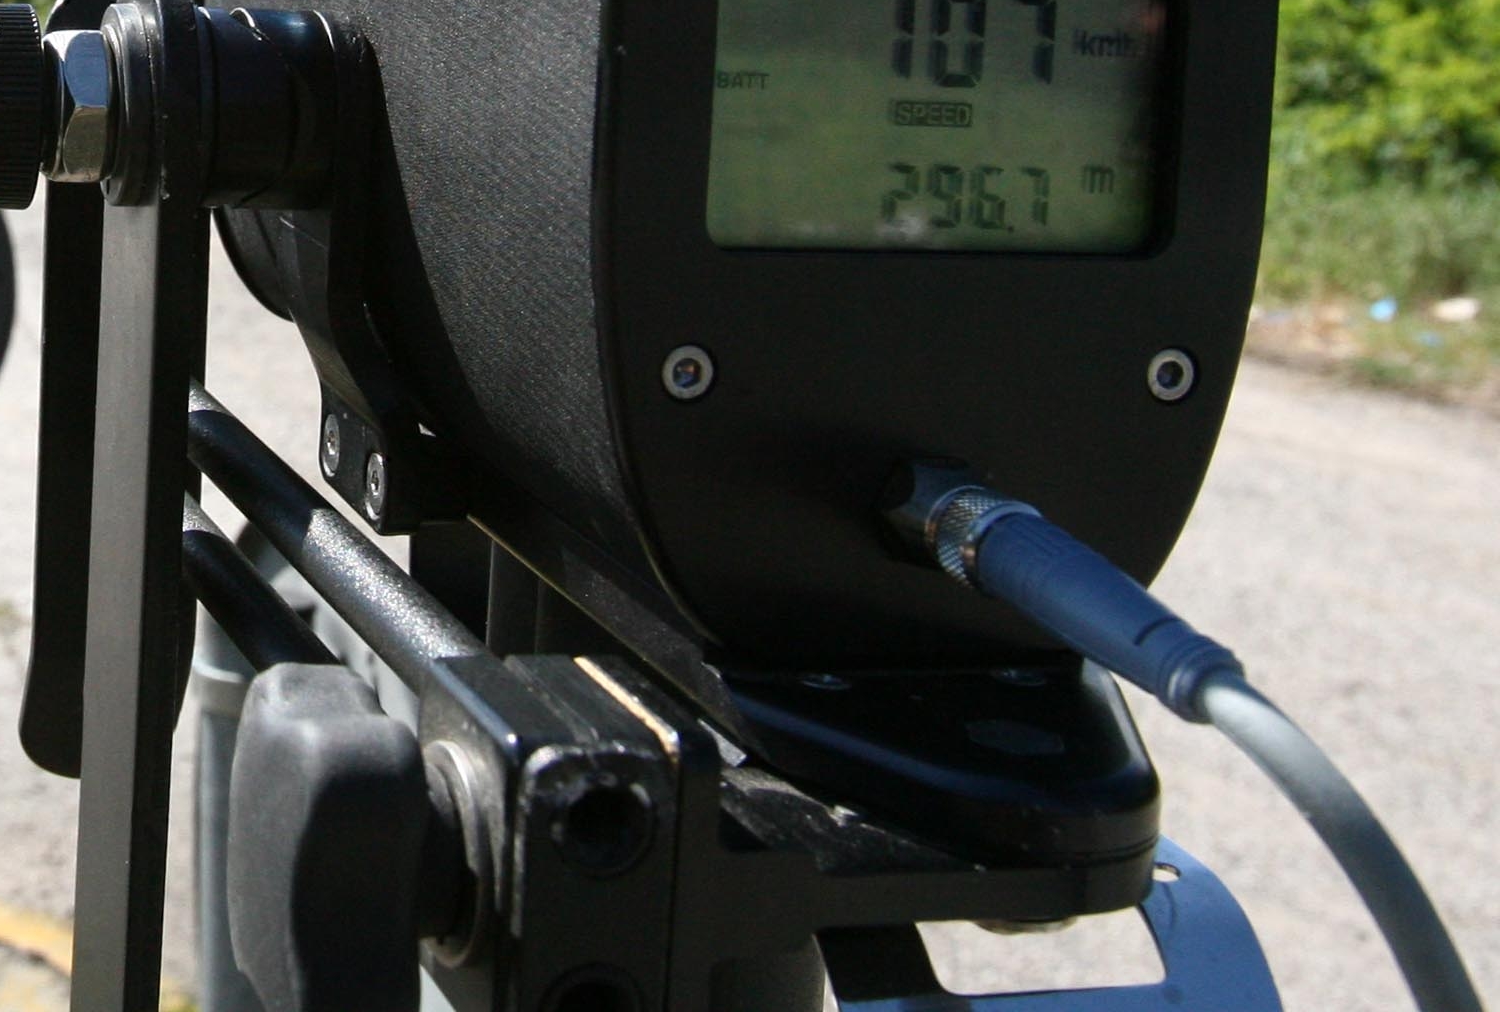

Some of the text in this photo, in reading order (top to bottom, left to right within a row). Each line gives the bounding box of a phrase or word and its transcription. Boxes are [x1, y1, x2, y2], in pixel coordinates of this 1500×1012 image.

[716, 71, 770, 90] BATT
[895, 101, 973, 127] SPEED
[1083, 164, 1115, 195] m
